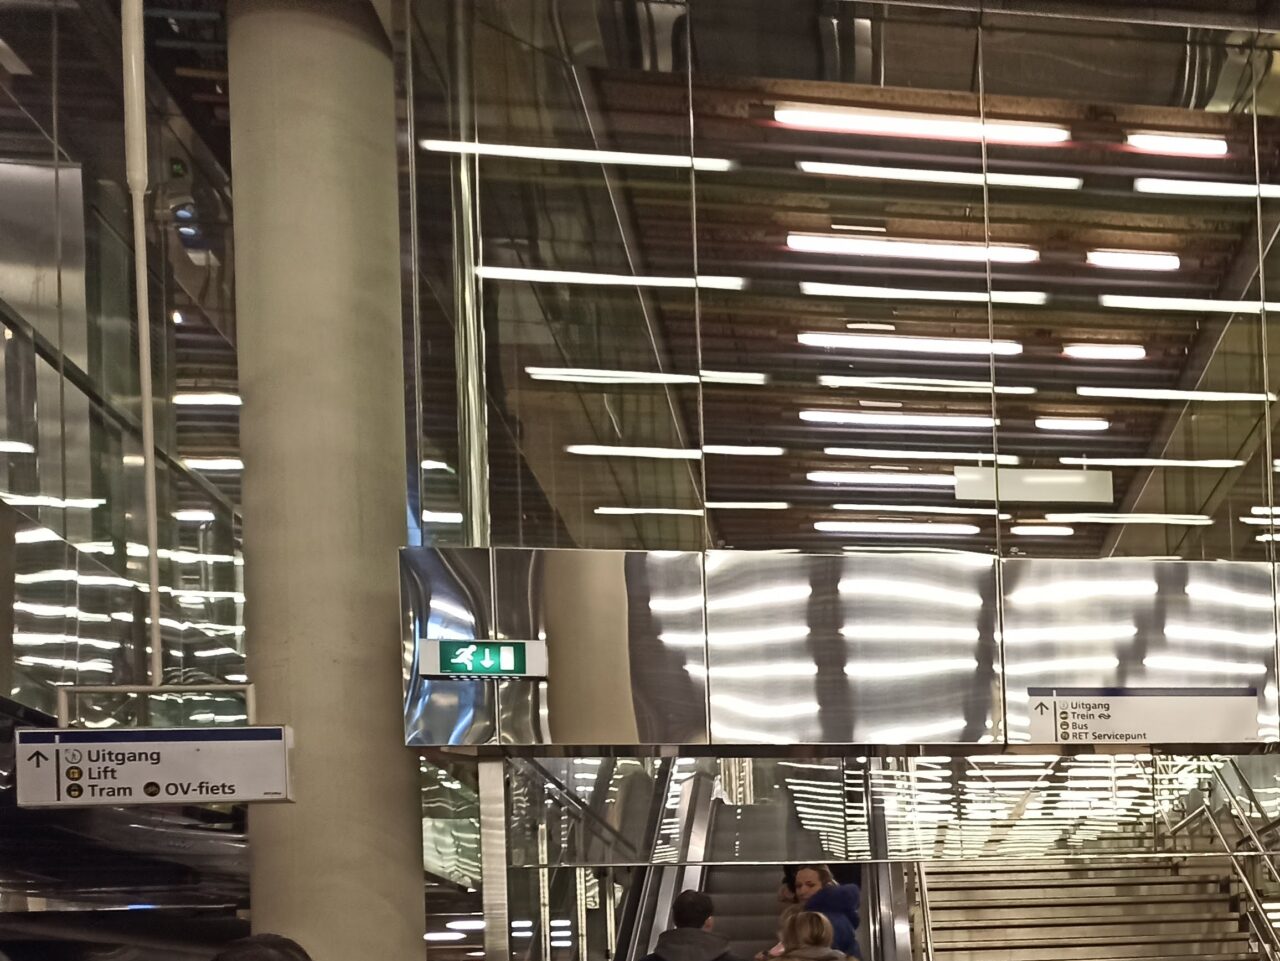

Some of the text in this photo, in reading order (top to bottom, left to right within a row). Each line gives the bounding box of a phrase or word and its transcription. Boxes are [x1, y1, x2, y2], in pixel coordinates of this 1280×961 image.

[1071, 701, 1110, 712] Uitgang
[1071, 712, 1095, 720] Trein
[1072, 722, 1088, 730] Bus
[1072, 731, 1147, 743] RET Servicepunt
[87, 749, 161, 765] Uitgang
[88, 767, 117, 780] Lift
[88, 782, 236, 797] Tram OV-fiets
